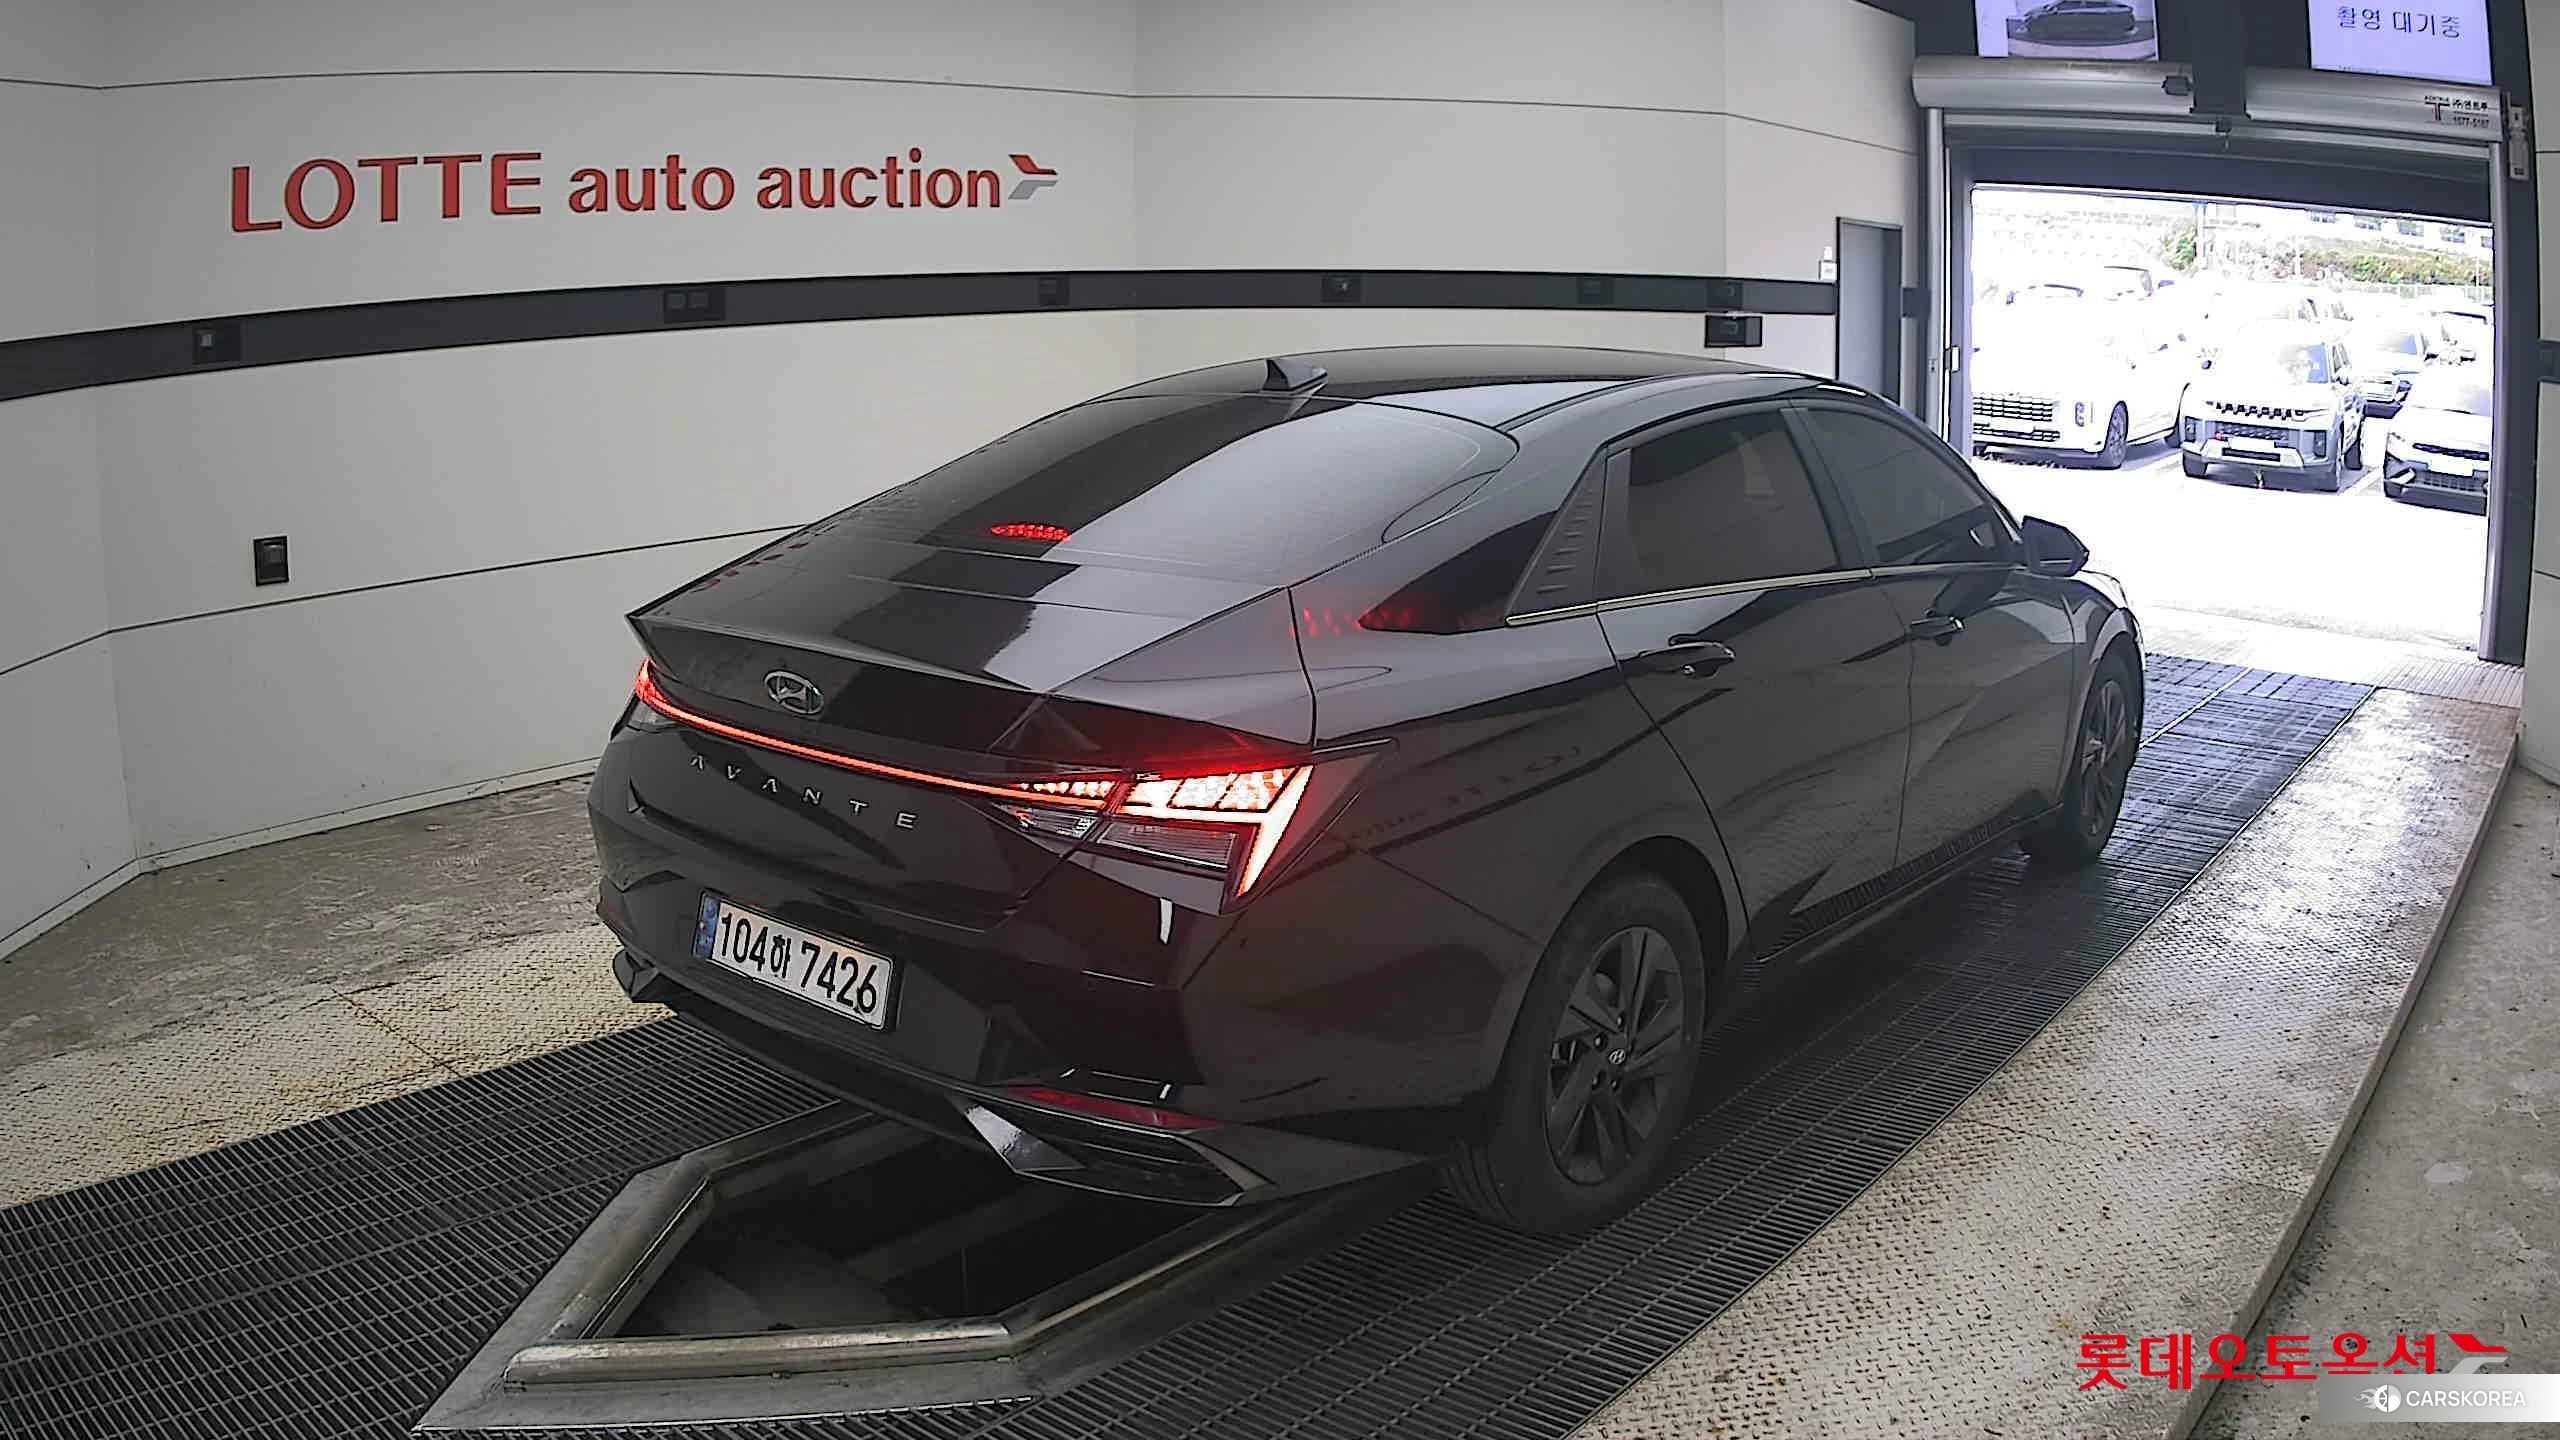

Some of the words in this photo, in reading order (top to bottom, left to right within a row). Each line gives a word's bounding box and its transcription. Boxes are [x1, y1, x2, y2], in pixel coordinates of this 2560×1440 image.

[2338, 6, 2381, 31] 촬영
[2392, 11, 2460, 39] 대기중
[232, 152, 542, 233] LOTTE
[569, 154, 736, 213] auto
[756, 148, 1001, 210] auction
[690, 754, 917, 829] AVANTE
[721, 912, 792, 979] 104하
[800, 940, 877, 1014] 7426
